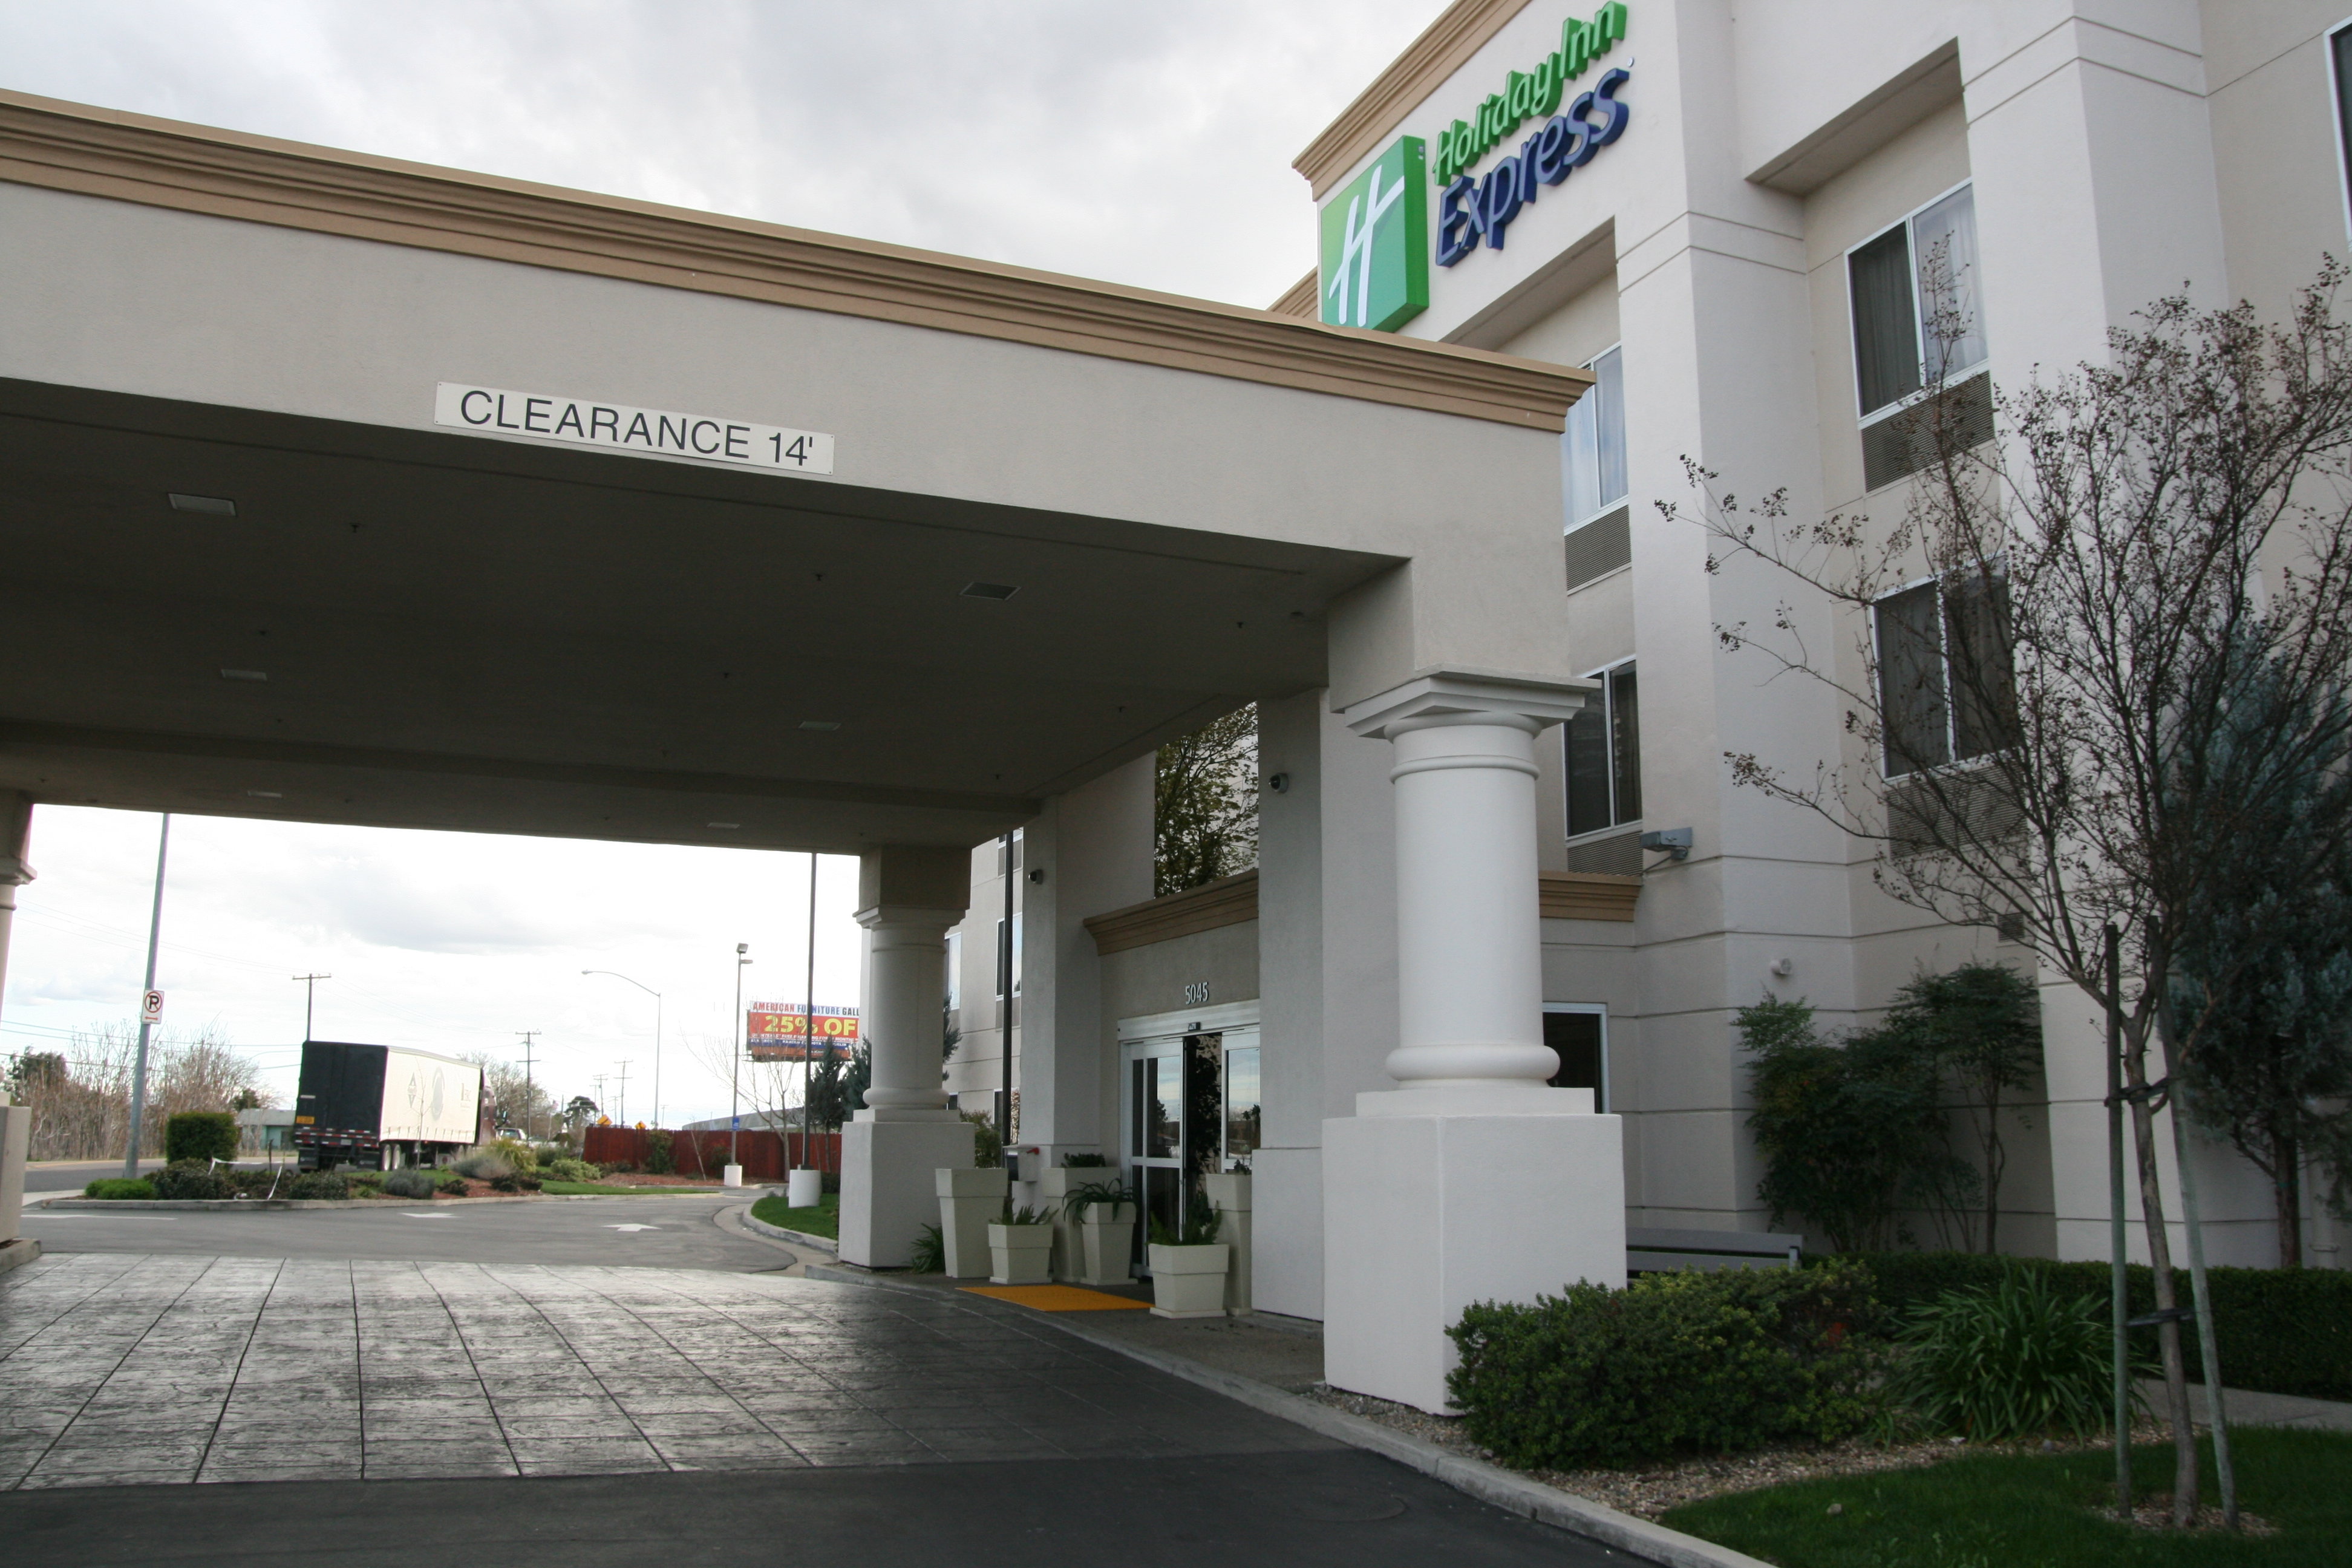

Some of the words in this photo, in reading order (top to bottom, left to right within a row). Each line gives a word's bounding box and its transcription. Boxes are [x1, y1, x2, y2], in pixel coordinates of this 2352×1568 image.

[1432, 52, 1563, 186] Holiday
[1559, 1, 1627, 80] Inn
[1436, 68, 1630, 267] Express
[460, 390, 751, 459] CLEARANCE
[768, 433, 813, 466] 14'
[753, 1002, 795, 1012] AMERICAN
[797, 1004, 840, 1015] FUNITURE
[1185, 982, 1209, 1005] 5045
[764, 1014, 818, 1034] 25%
[824, 1018, 859, 1036] OF
